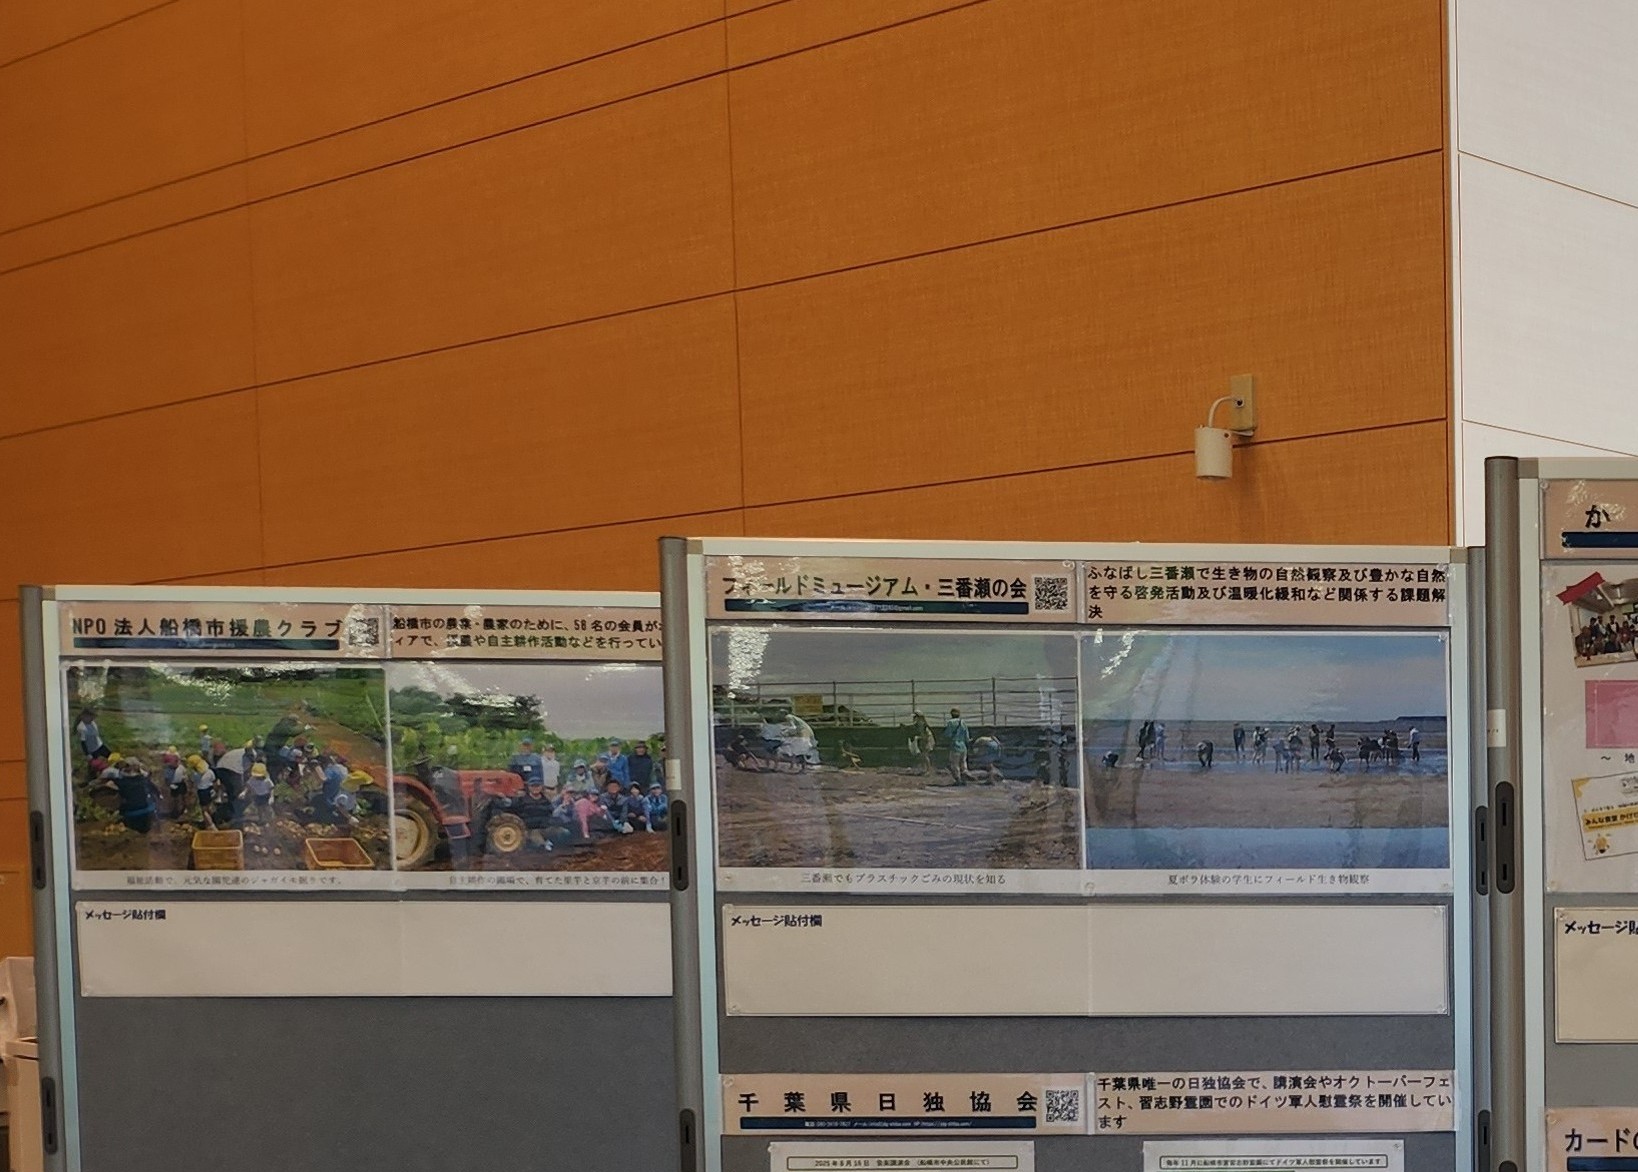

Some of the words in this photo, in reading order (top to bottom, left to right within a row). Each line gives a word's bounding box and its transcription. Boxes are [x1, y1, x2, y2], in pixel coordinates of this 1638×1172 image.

[1585, 504, 1612, 529] か
[1088, 605, 1103, 619] 決
[84, 908, 167, 921] メッセージ貼付欄
[731, 913, 823, 928] メッセージ貼付欄
[738, 1091, 1038, 1113] 千葉県日独協会
[1099, 1114, 1128, 1129] ます
[1565, 1128, 1638, 1153] カード
